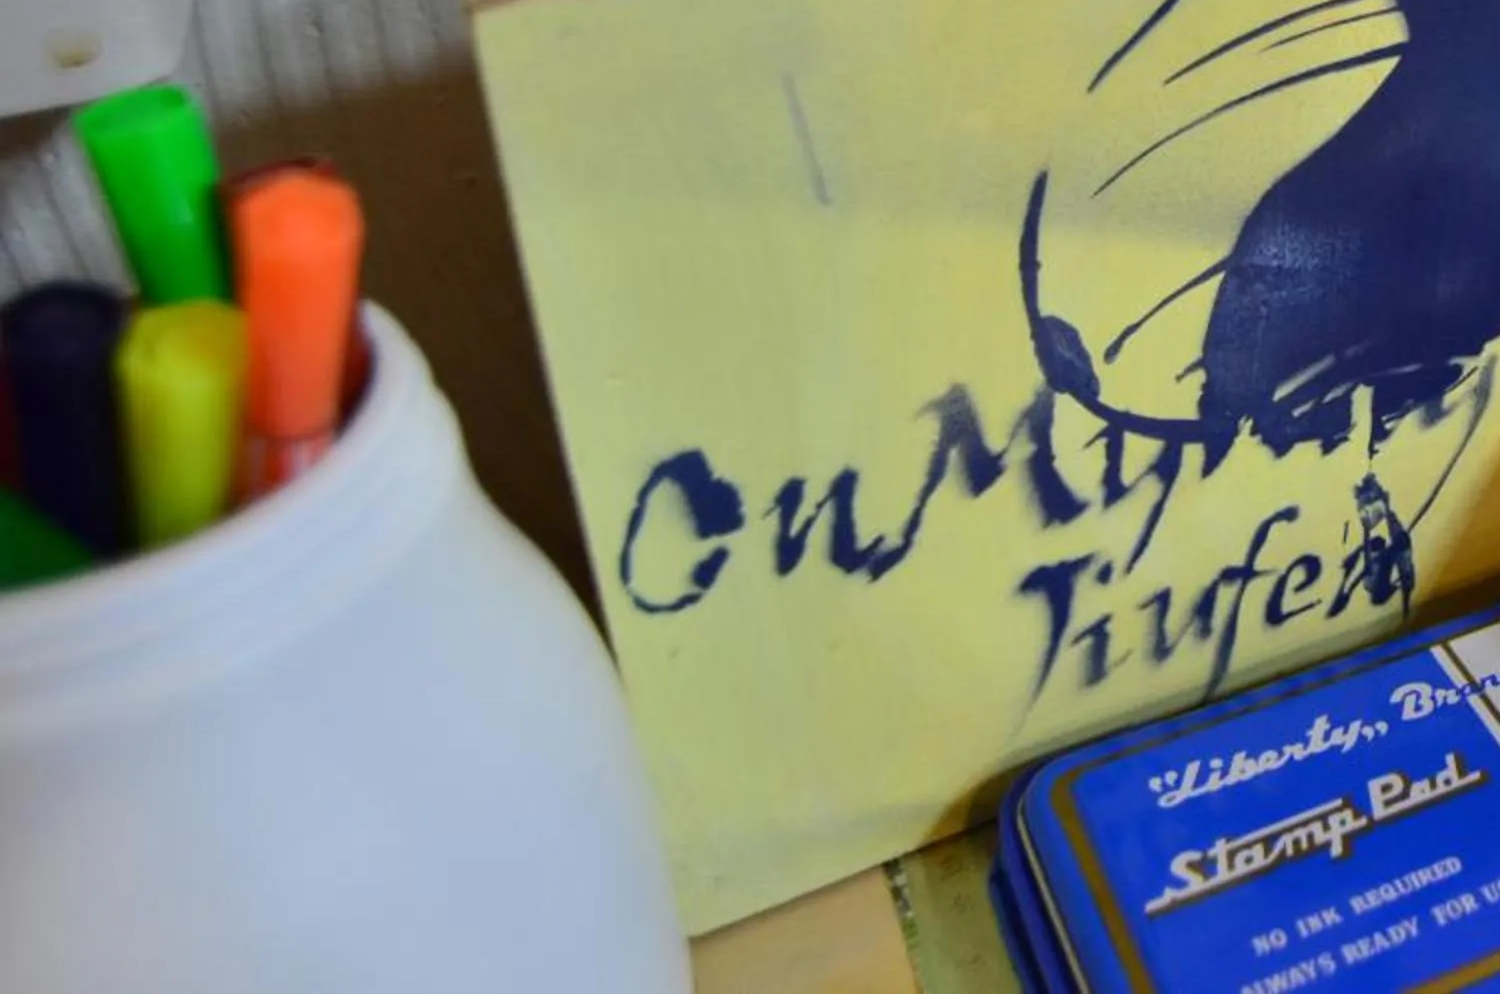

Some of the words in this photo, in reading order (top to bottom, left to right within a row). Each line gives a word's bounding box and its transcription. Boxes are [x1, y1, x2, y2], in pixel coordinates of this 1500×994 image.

[1144, 796, 1368, 916] Stamp
[1366, 751, 1484, 822] Pad
[1251, 926, 1289, 957] NO
[1295, 904, 1343, 939] INK
[1349, 854, 1463, 915] REQUIRED
[1340, 914, 1421, 965] READY
[1429, 892, 1480, 927] FOR
